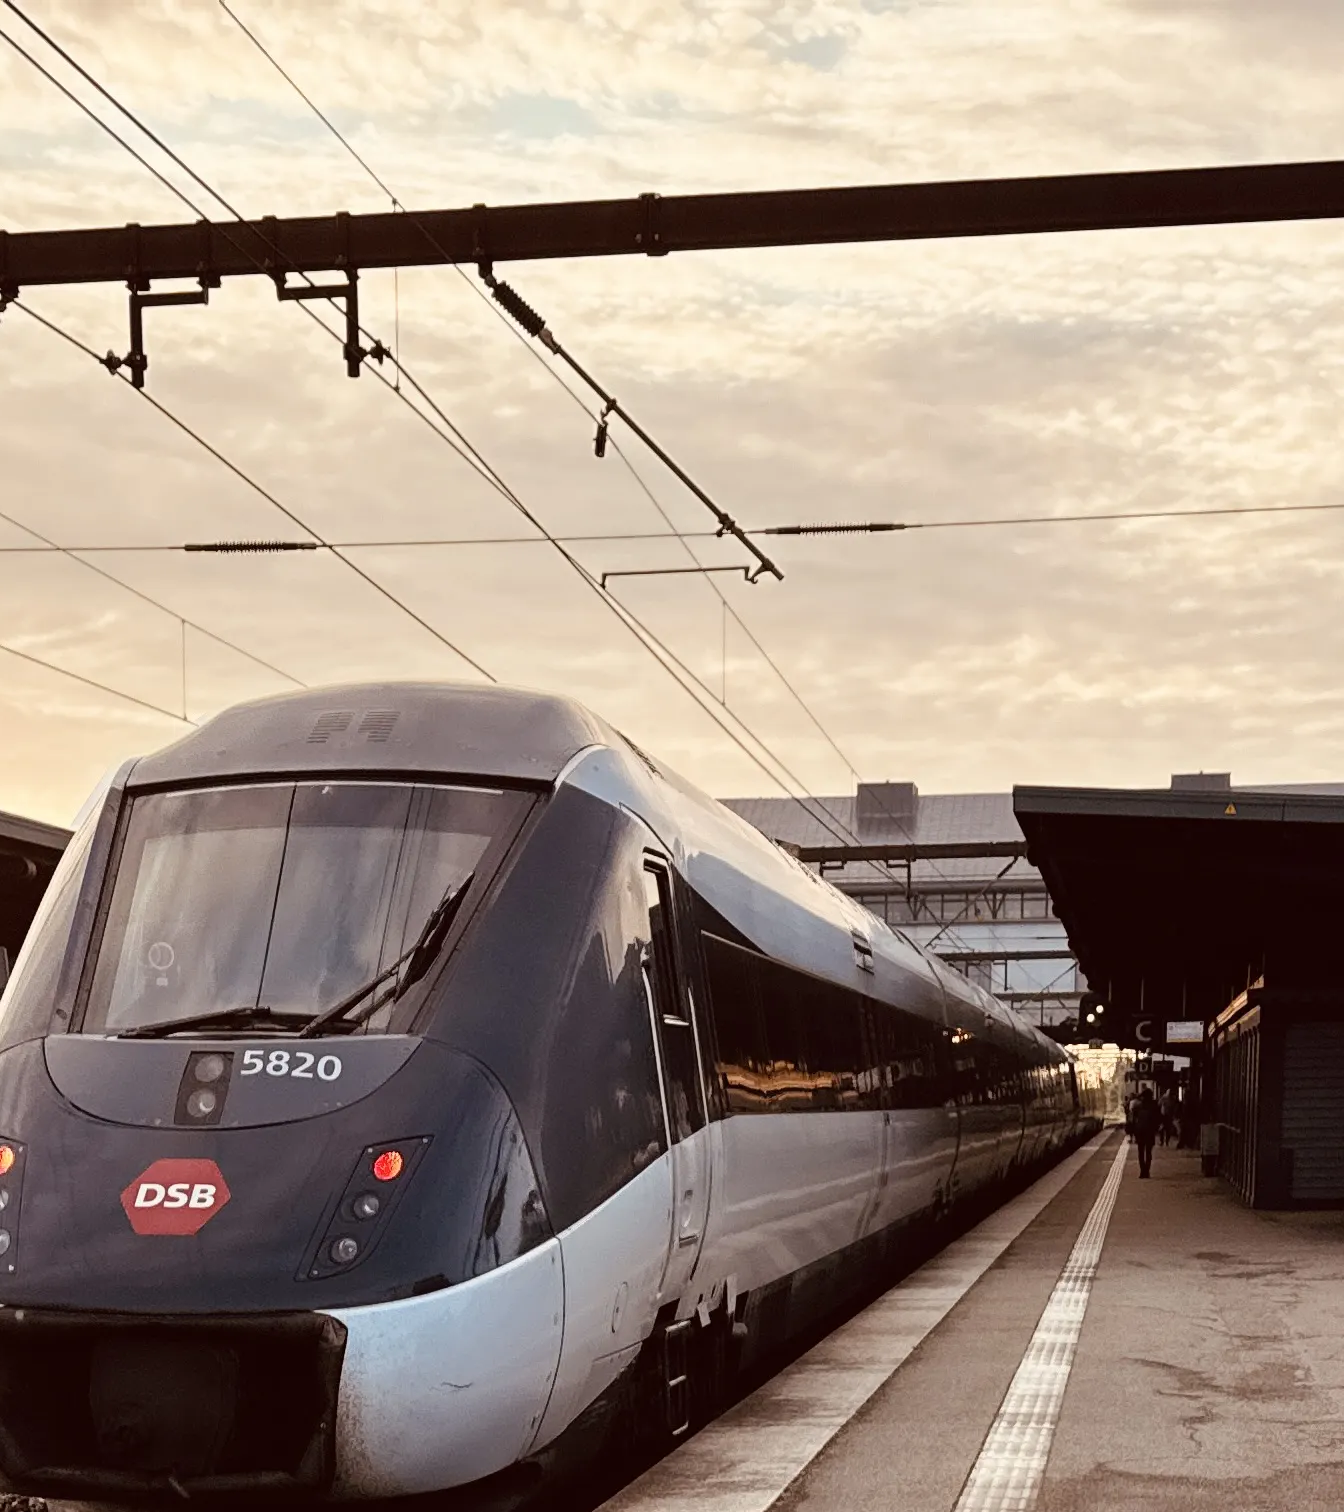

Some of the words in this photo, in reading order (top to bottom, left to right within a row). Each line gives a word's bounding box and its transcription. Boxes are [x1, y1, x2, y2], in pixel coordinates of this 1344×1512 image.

[1135, 1020, 1153, 1042] C
[240, 1050, 342, 1081] 5820
[134, 1183, 216, 1209] DSB
